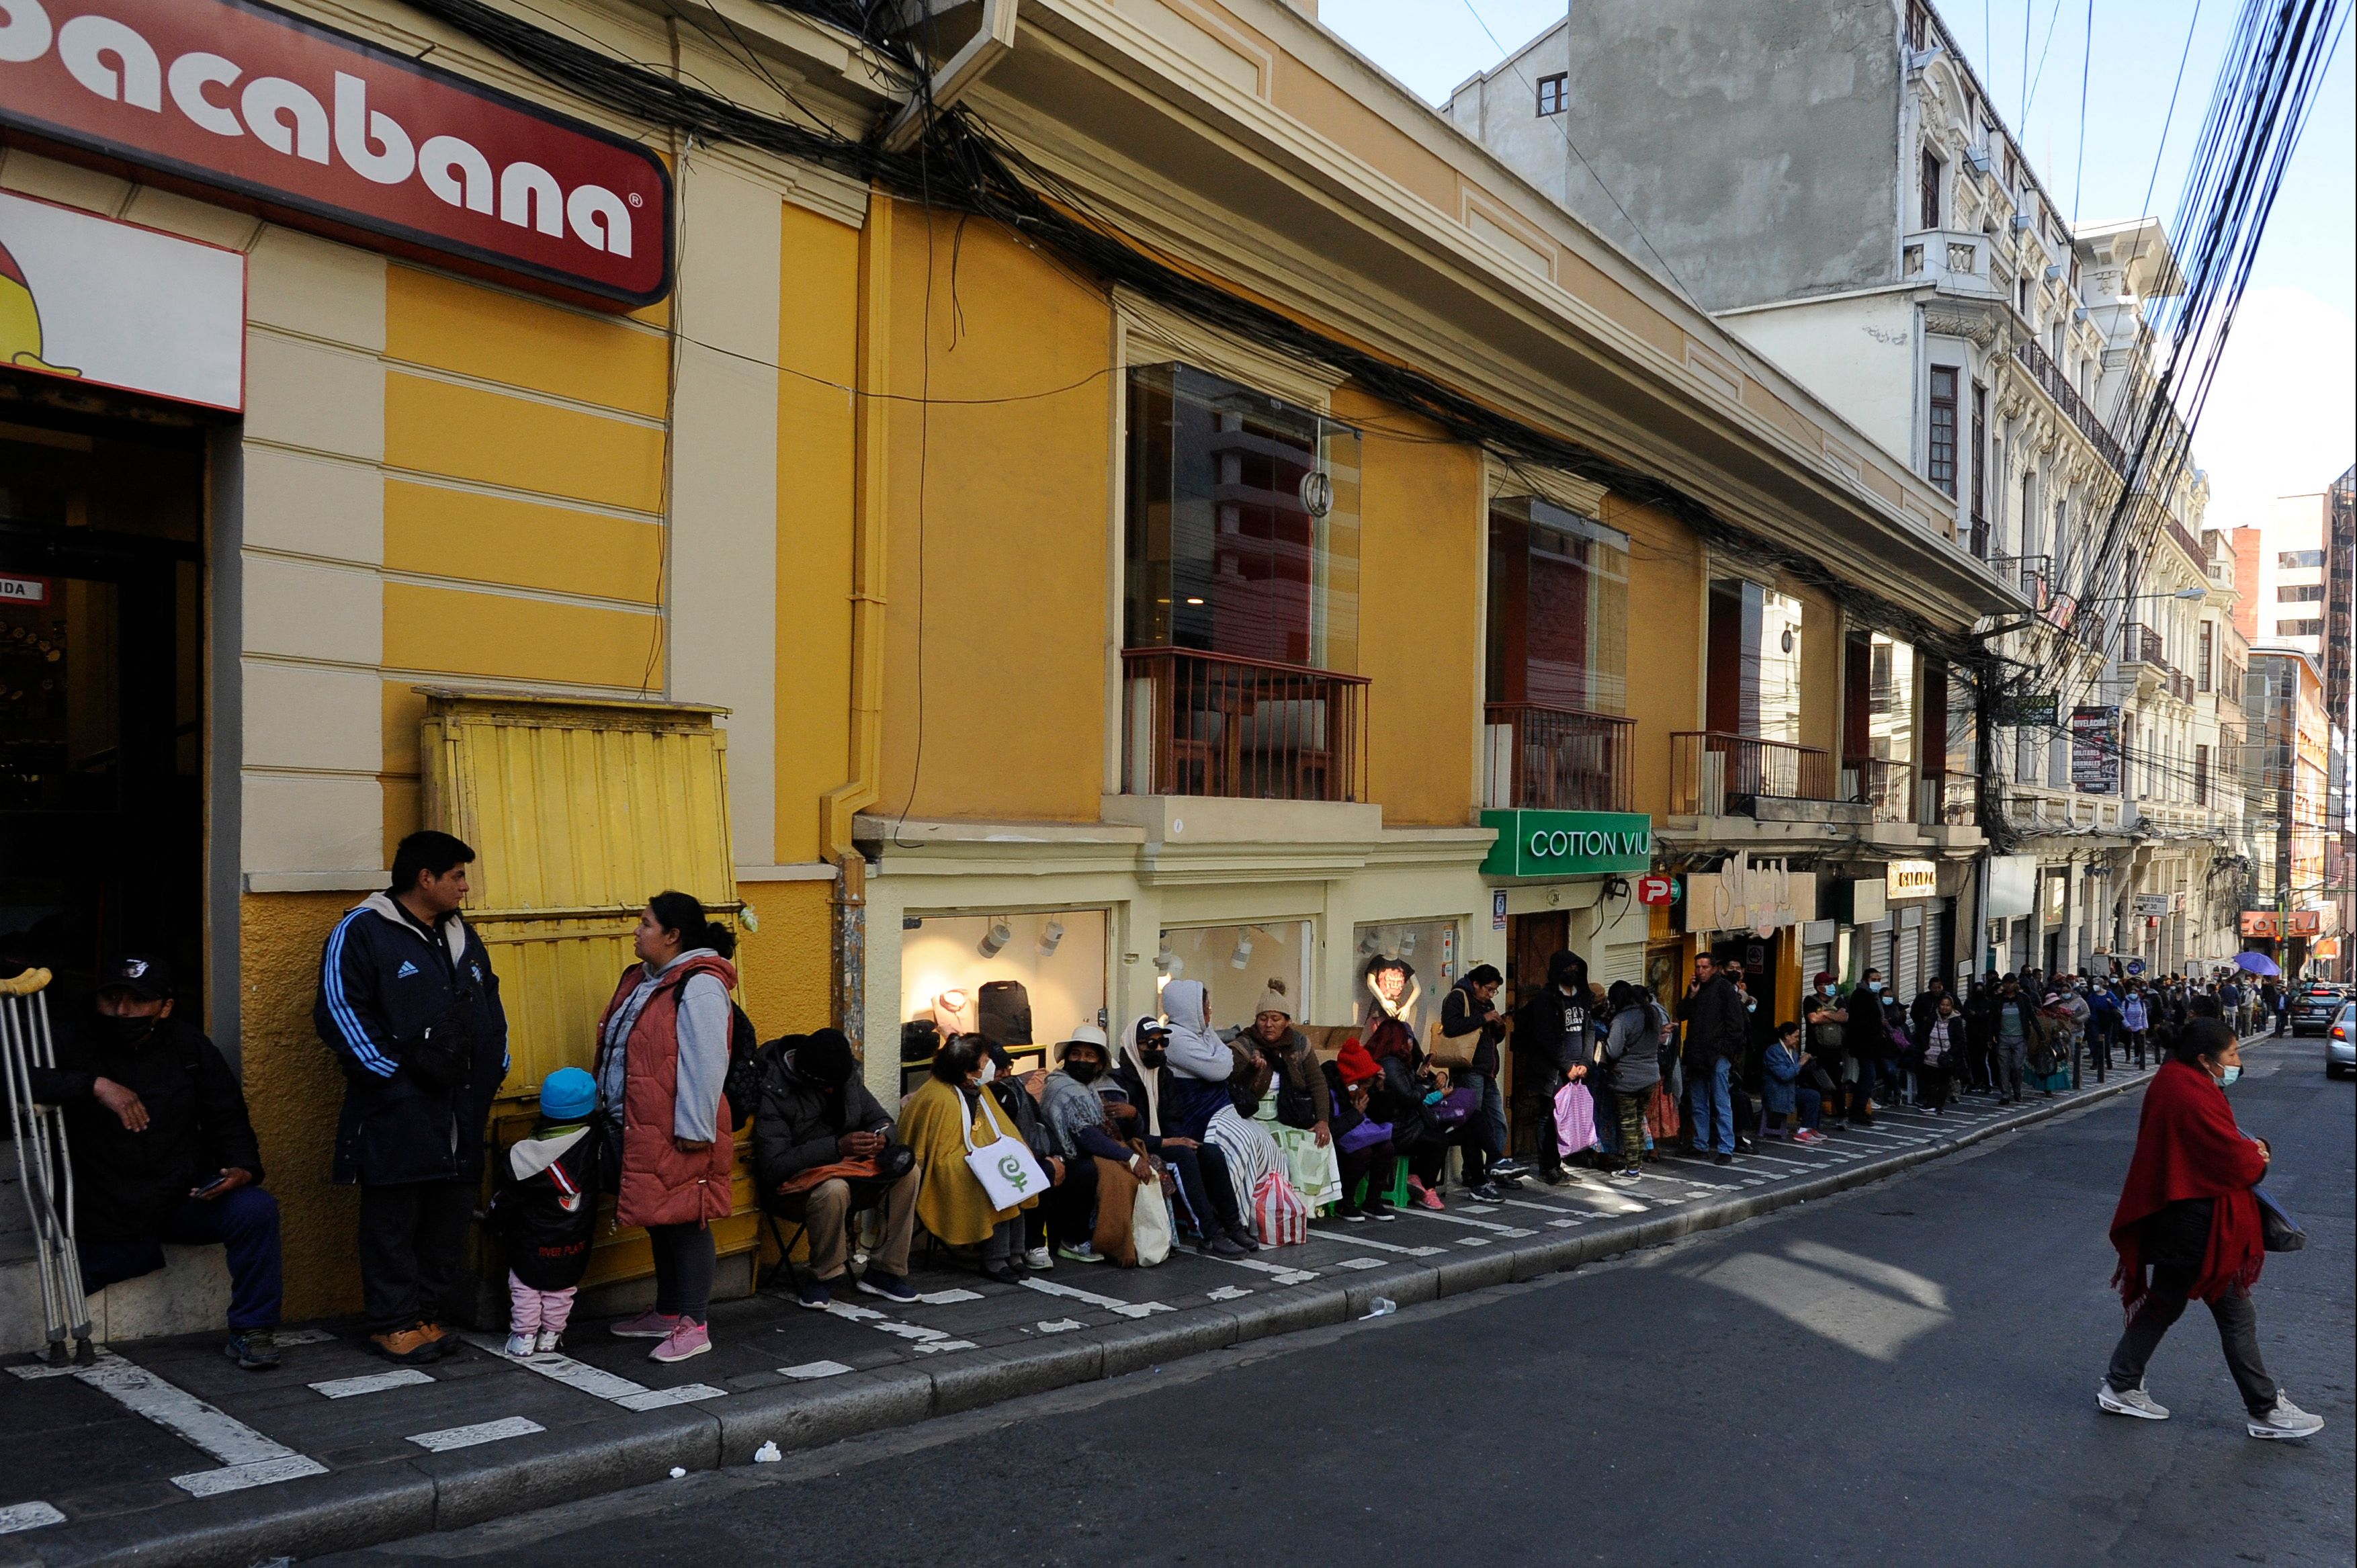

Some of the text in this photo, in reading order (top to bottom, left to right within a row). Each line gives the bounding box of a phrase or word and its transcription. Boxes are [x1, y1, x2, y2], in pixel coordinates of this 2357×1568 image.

[0, 582, 26, 595] DA
[1531, 830, 1649, 857] COTTON VIU
